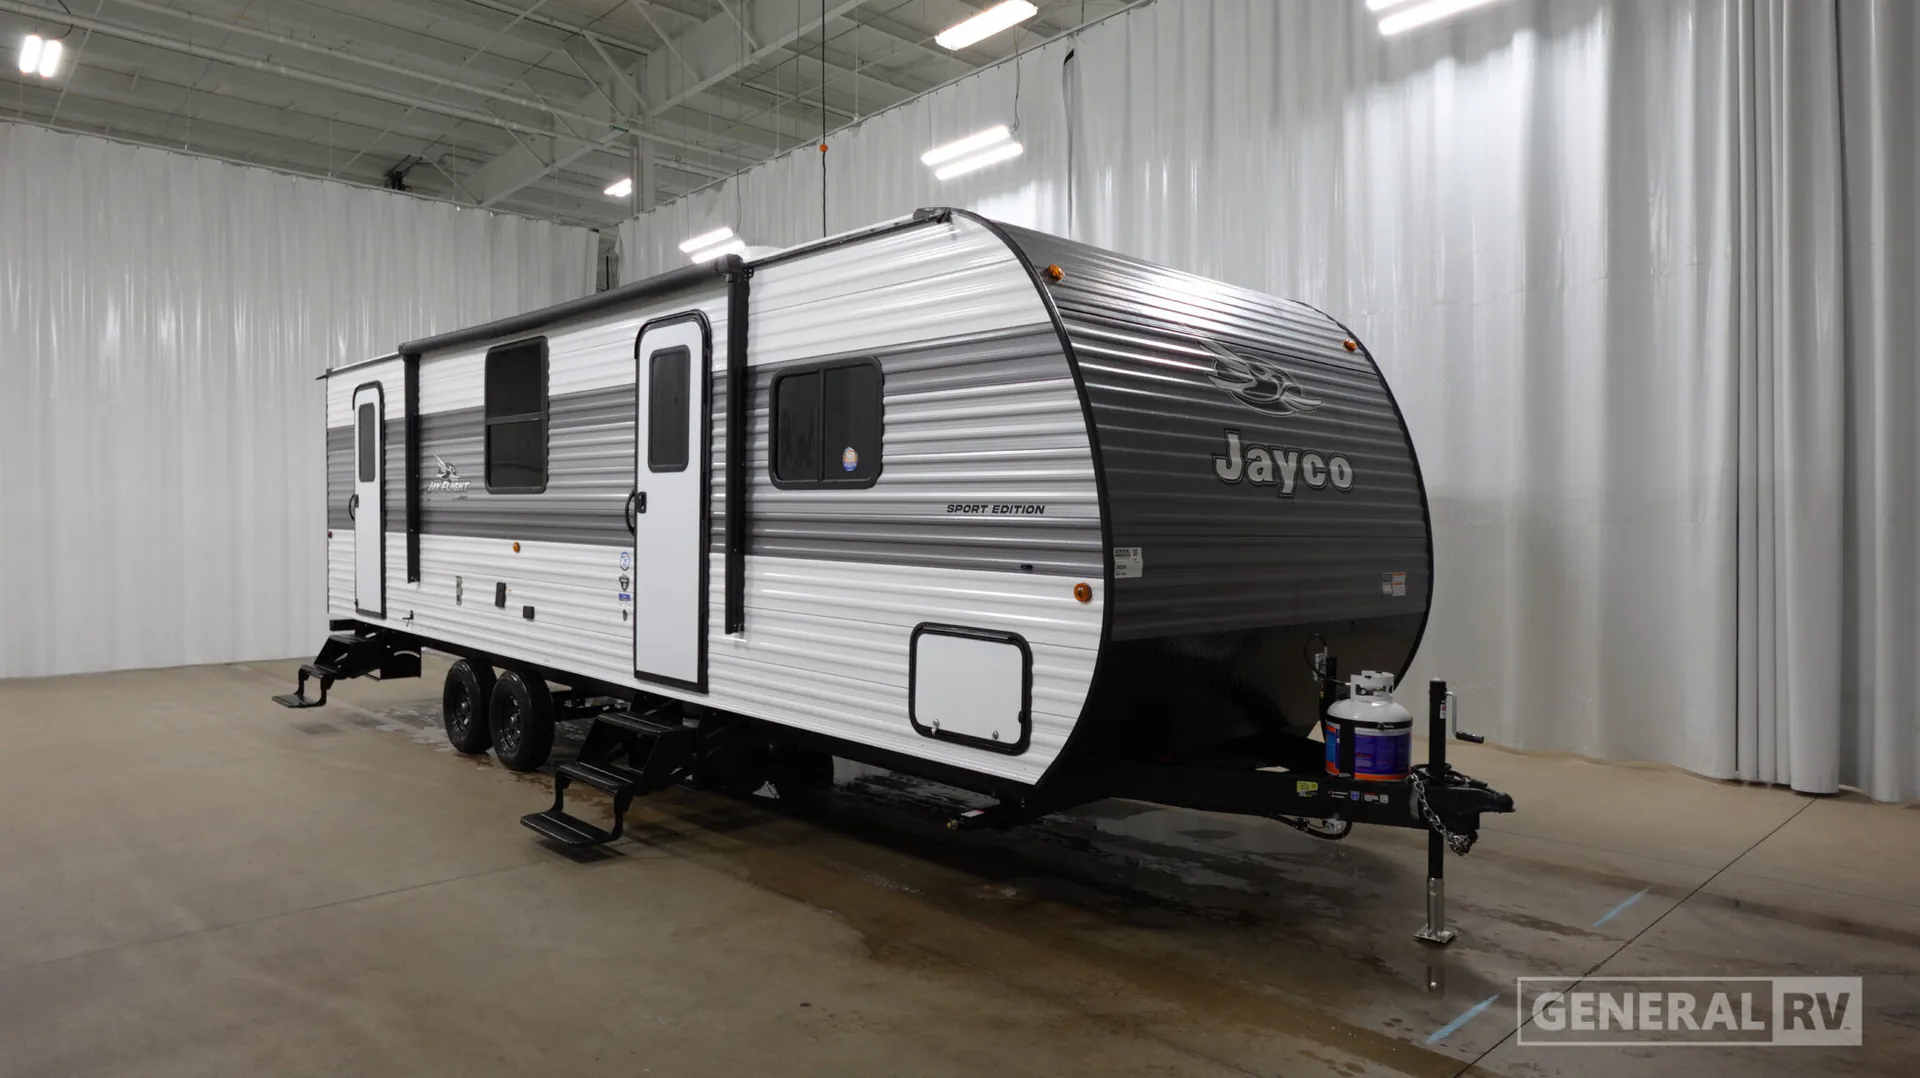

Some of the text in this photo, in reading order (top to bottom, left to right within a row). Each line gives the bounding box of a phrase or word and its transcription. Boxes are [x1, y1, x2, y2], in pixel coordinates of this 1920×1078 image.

[1212, 429, 1354, 498] Jayco
[441, 481, 471, 492] FLIGHT
[946, 504, 1046, 515] SPORT EDITION
